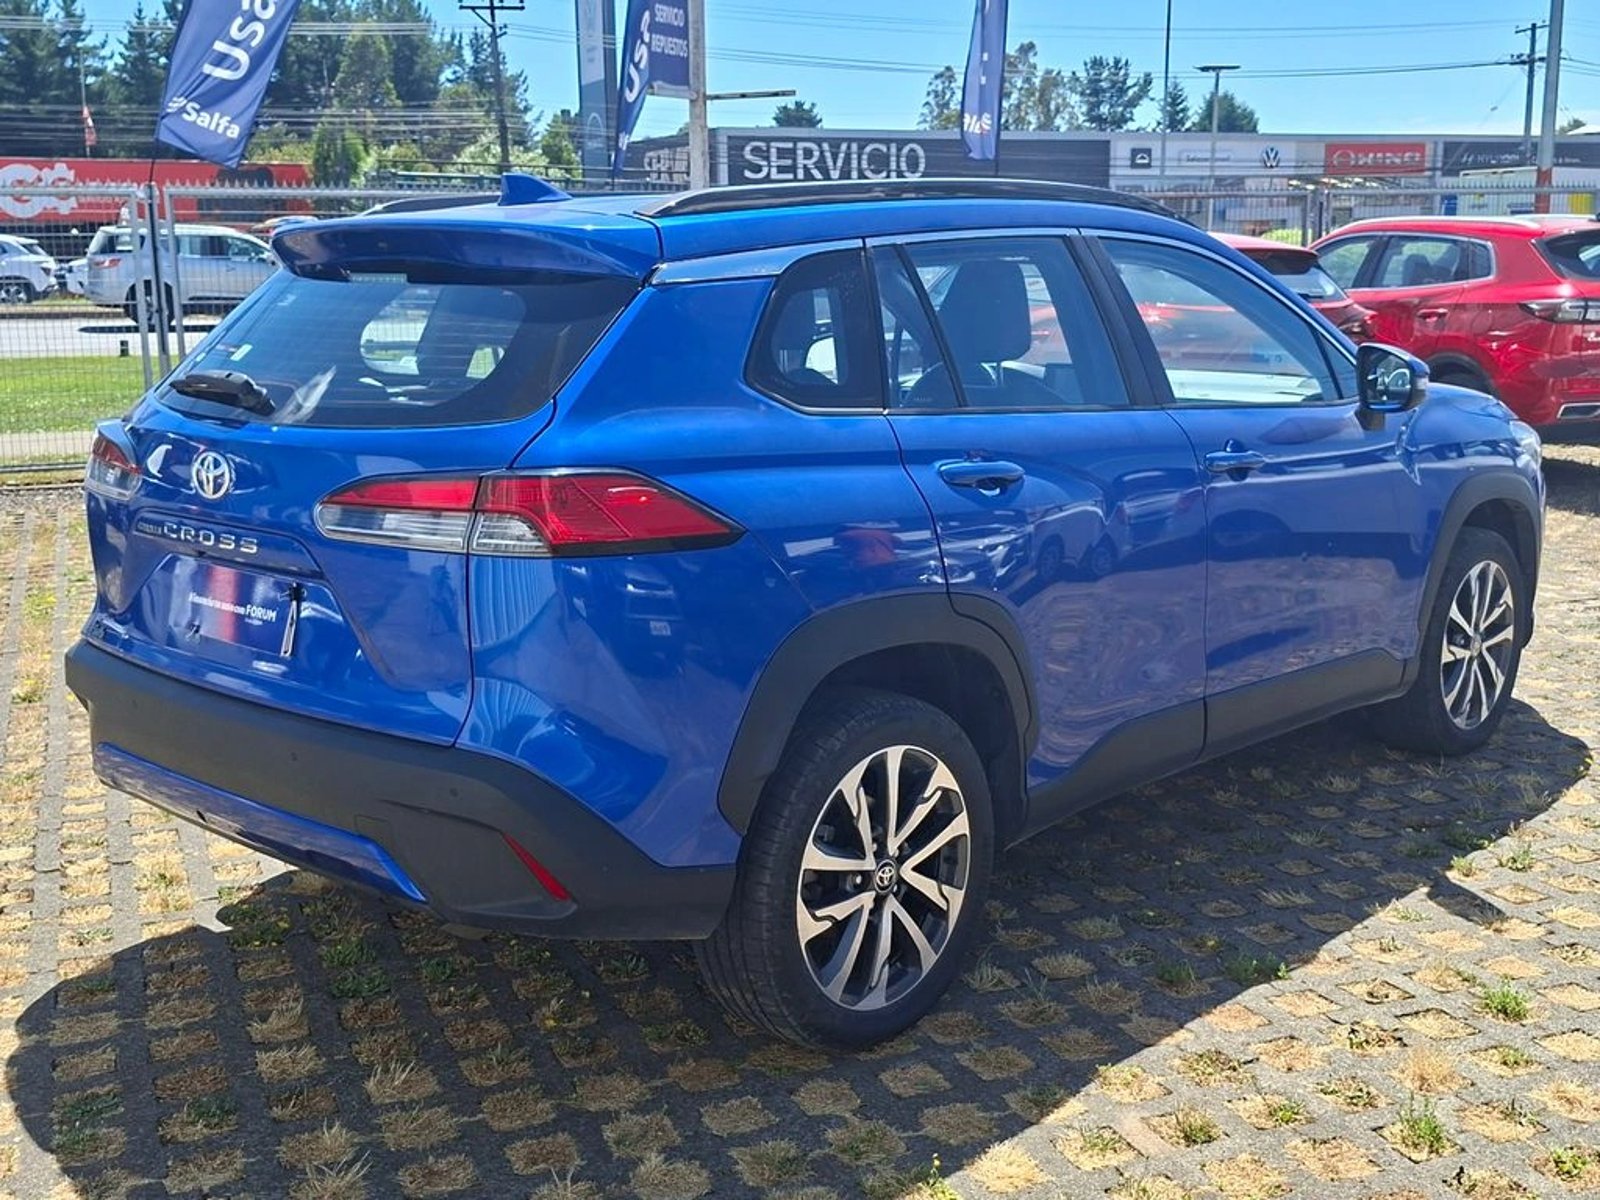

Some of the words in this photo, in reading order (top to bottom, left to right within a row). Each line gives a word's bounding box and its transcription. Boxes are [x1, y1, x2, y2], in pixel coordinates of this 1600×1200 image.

[655, 3, 685, 27] SERVICIO
[651, 33, 688, 58] REPUESTOS
[181, 101, 241, 139] Salfa
[743, 141, 926, 180] SERVICIO
[163, 521, 258, 554] CROSS
[245, 604, 277, 622] FORUM
